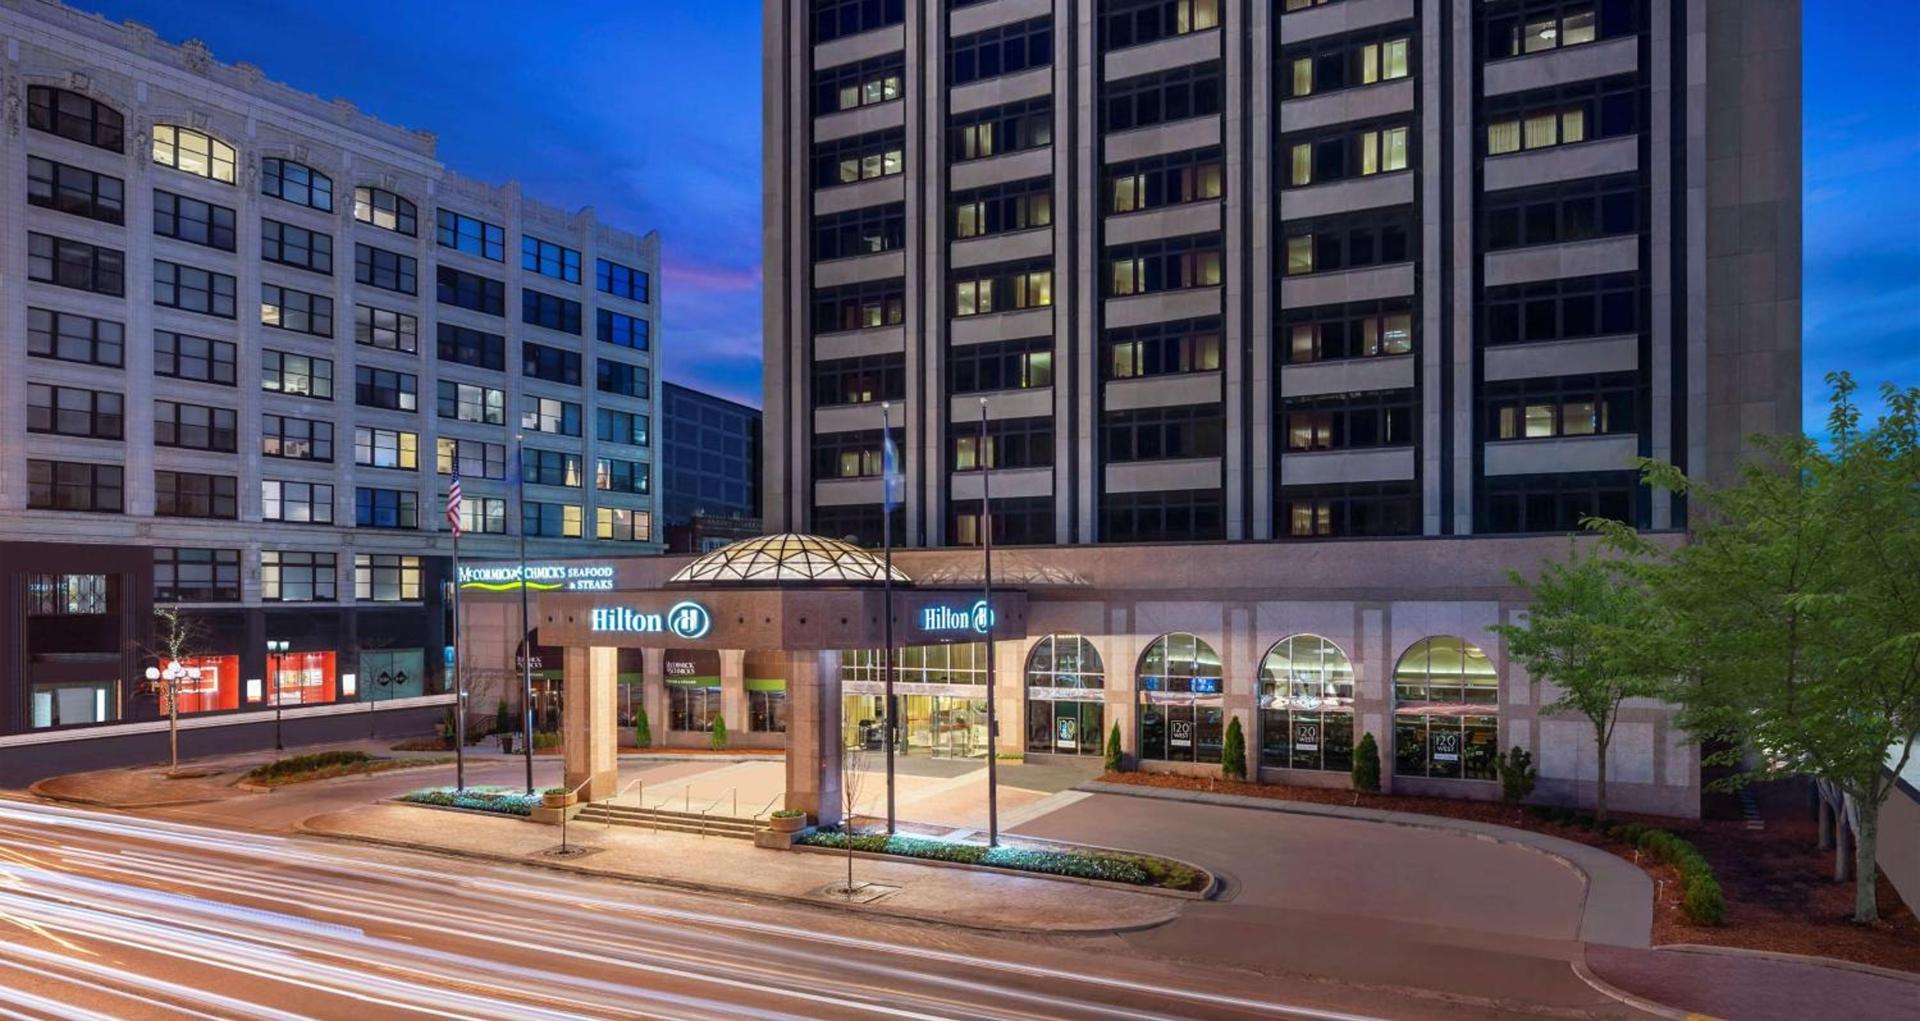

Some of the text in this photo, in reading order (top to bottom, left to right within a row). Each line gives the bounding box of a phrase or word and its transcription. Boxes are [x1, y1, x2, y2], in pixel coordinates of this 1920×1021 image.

[567, 567, 614, 577] SEAFOOD
[577, 580, 614, 590] STEAKS
[592, 607, 663, 632] Hilton
[925, 606, 969, 630] Hilton
[1173, 722, 1190, 733] 120
[1436, 735, 1456, 746] 120
